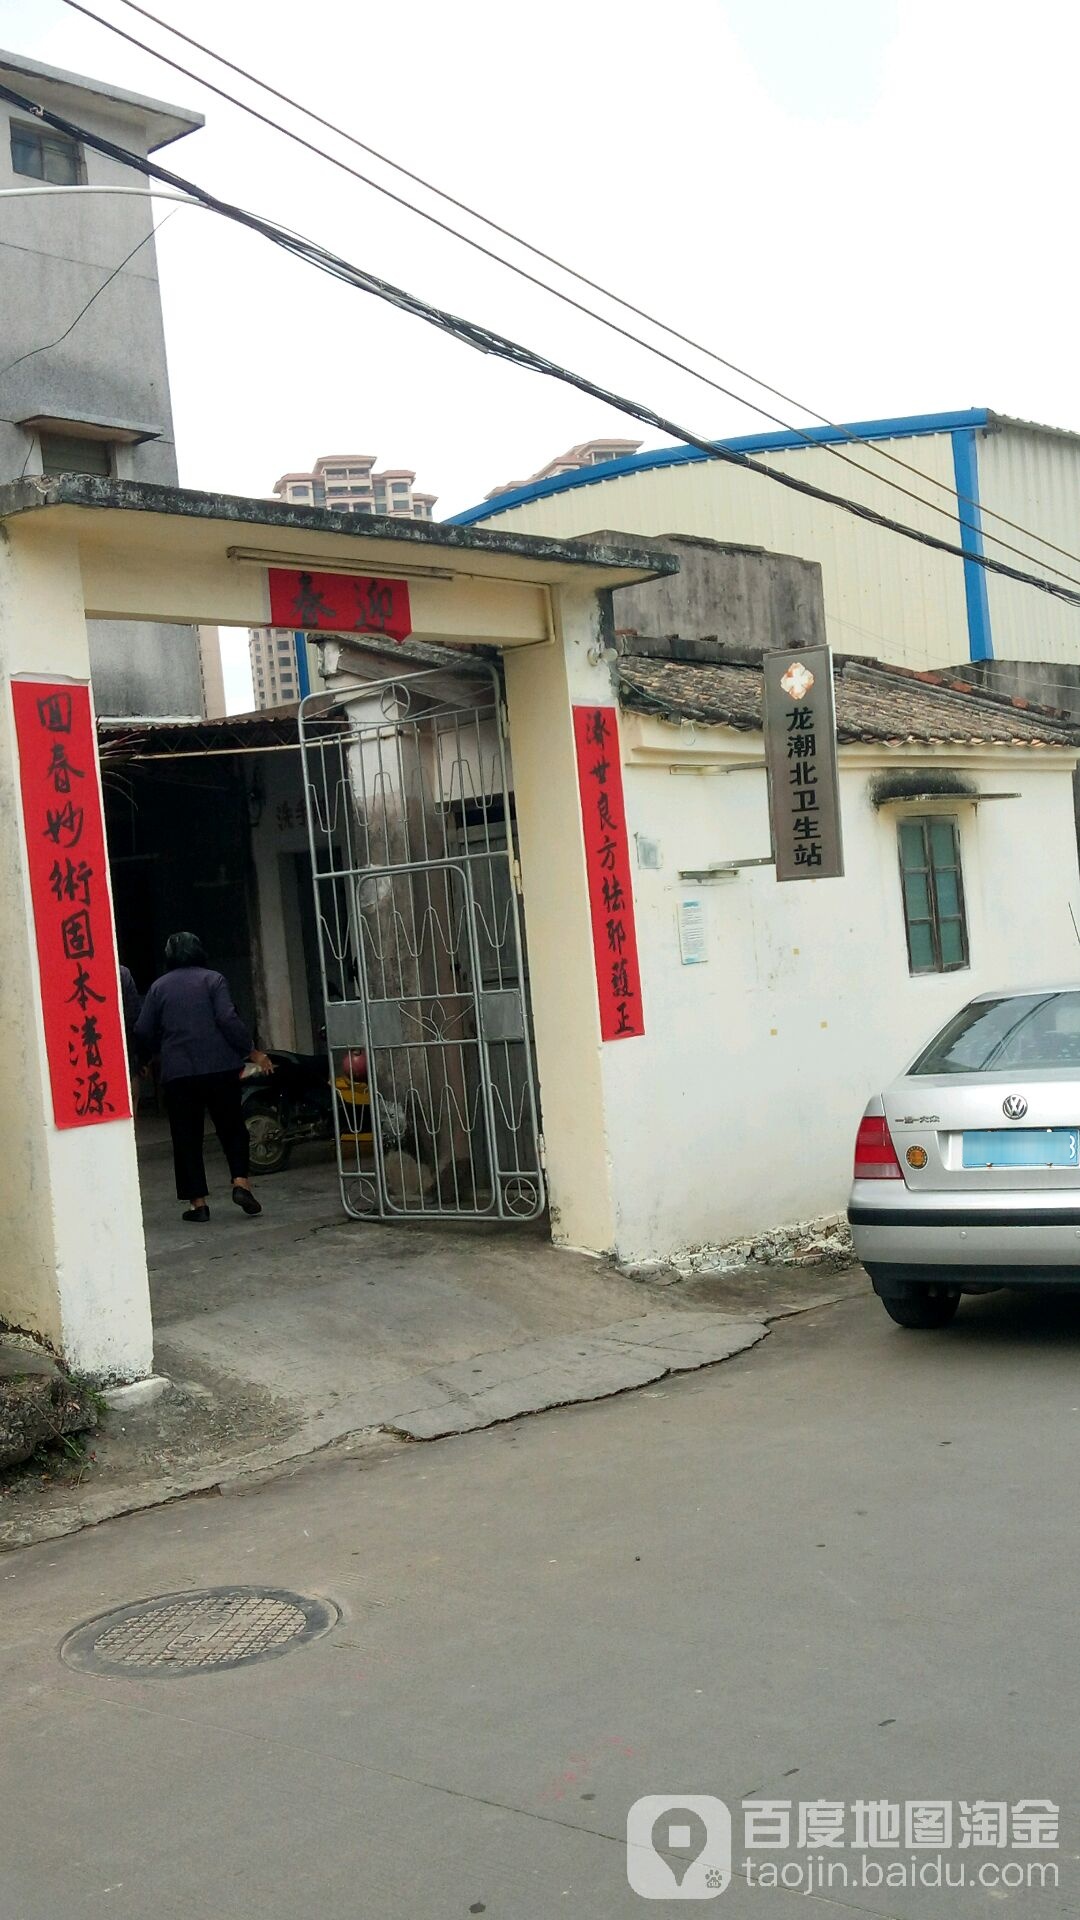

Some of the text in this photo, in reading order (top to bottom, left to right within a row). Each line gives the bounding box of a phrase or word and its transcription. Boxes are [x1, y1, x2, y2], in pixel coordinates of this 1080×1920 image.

[785, 706, 822, 867] 龙潮北卫生站
